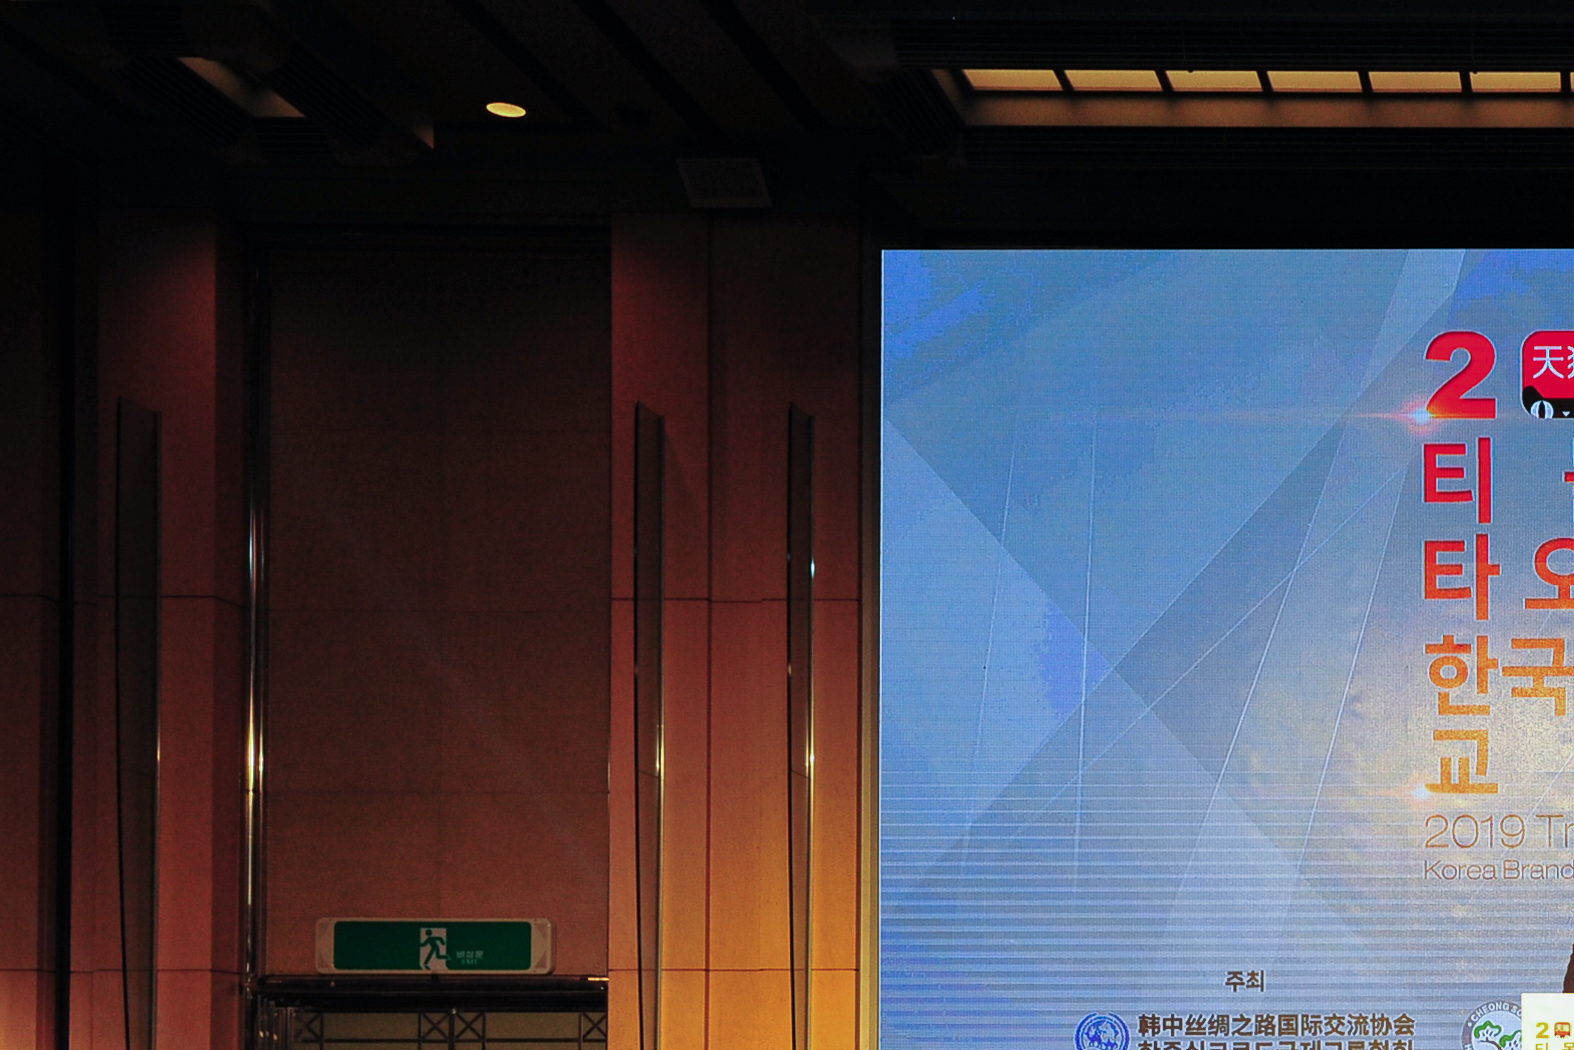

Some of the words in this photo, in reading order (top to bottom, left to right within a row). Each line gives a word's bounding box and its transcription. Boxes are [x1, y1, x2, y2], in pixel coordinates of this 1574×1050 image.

[1424, 813, 1526, 849] 2019
[1423, 859, 1497, 880] Korea
[1225, 970, 1266, 992] 주최
[1471, 1001, 1510, 1022] CHEONG
[1138, 1013, 1415, 1037] 韩中丝绸之路国际交流协会
